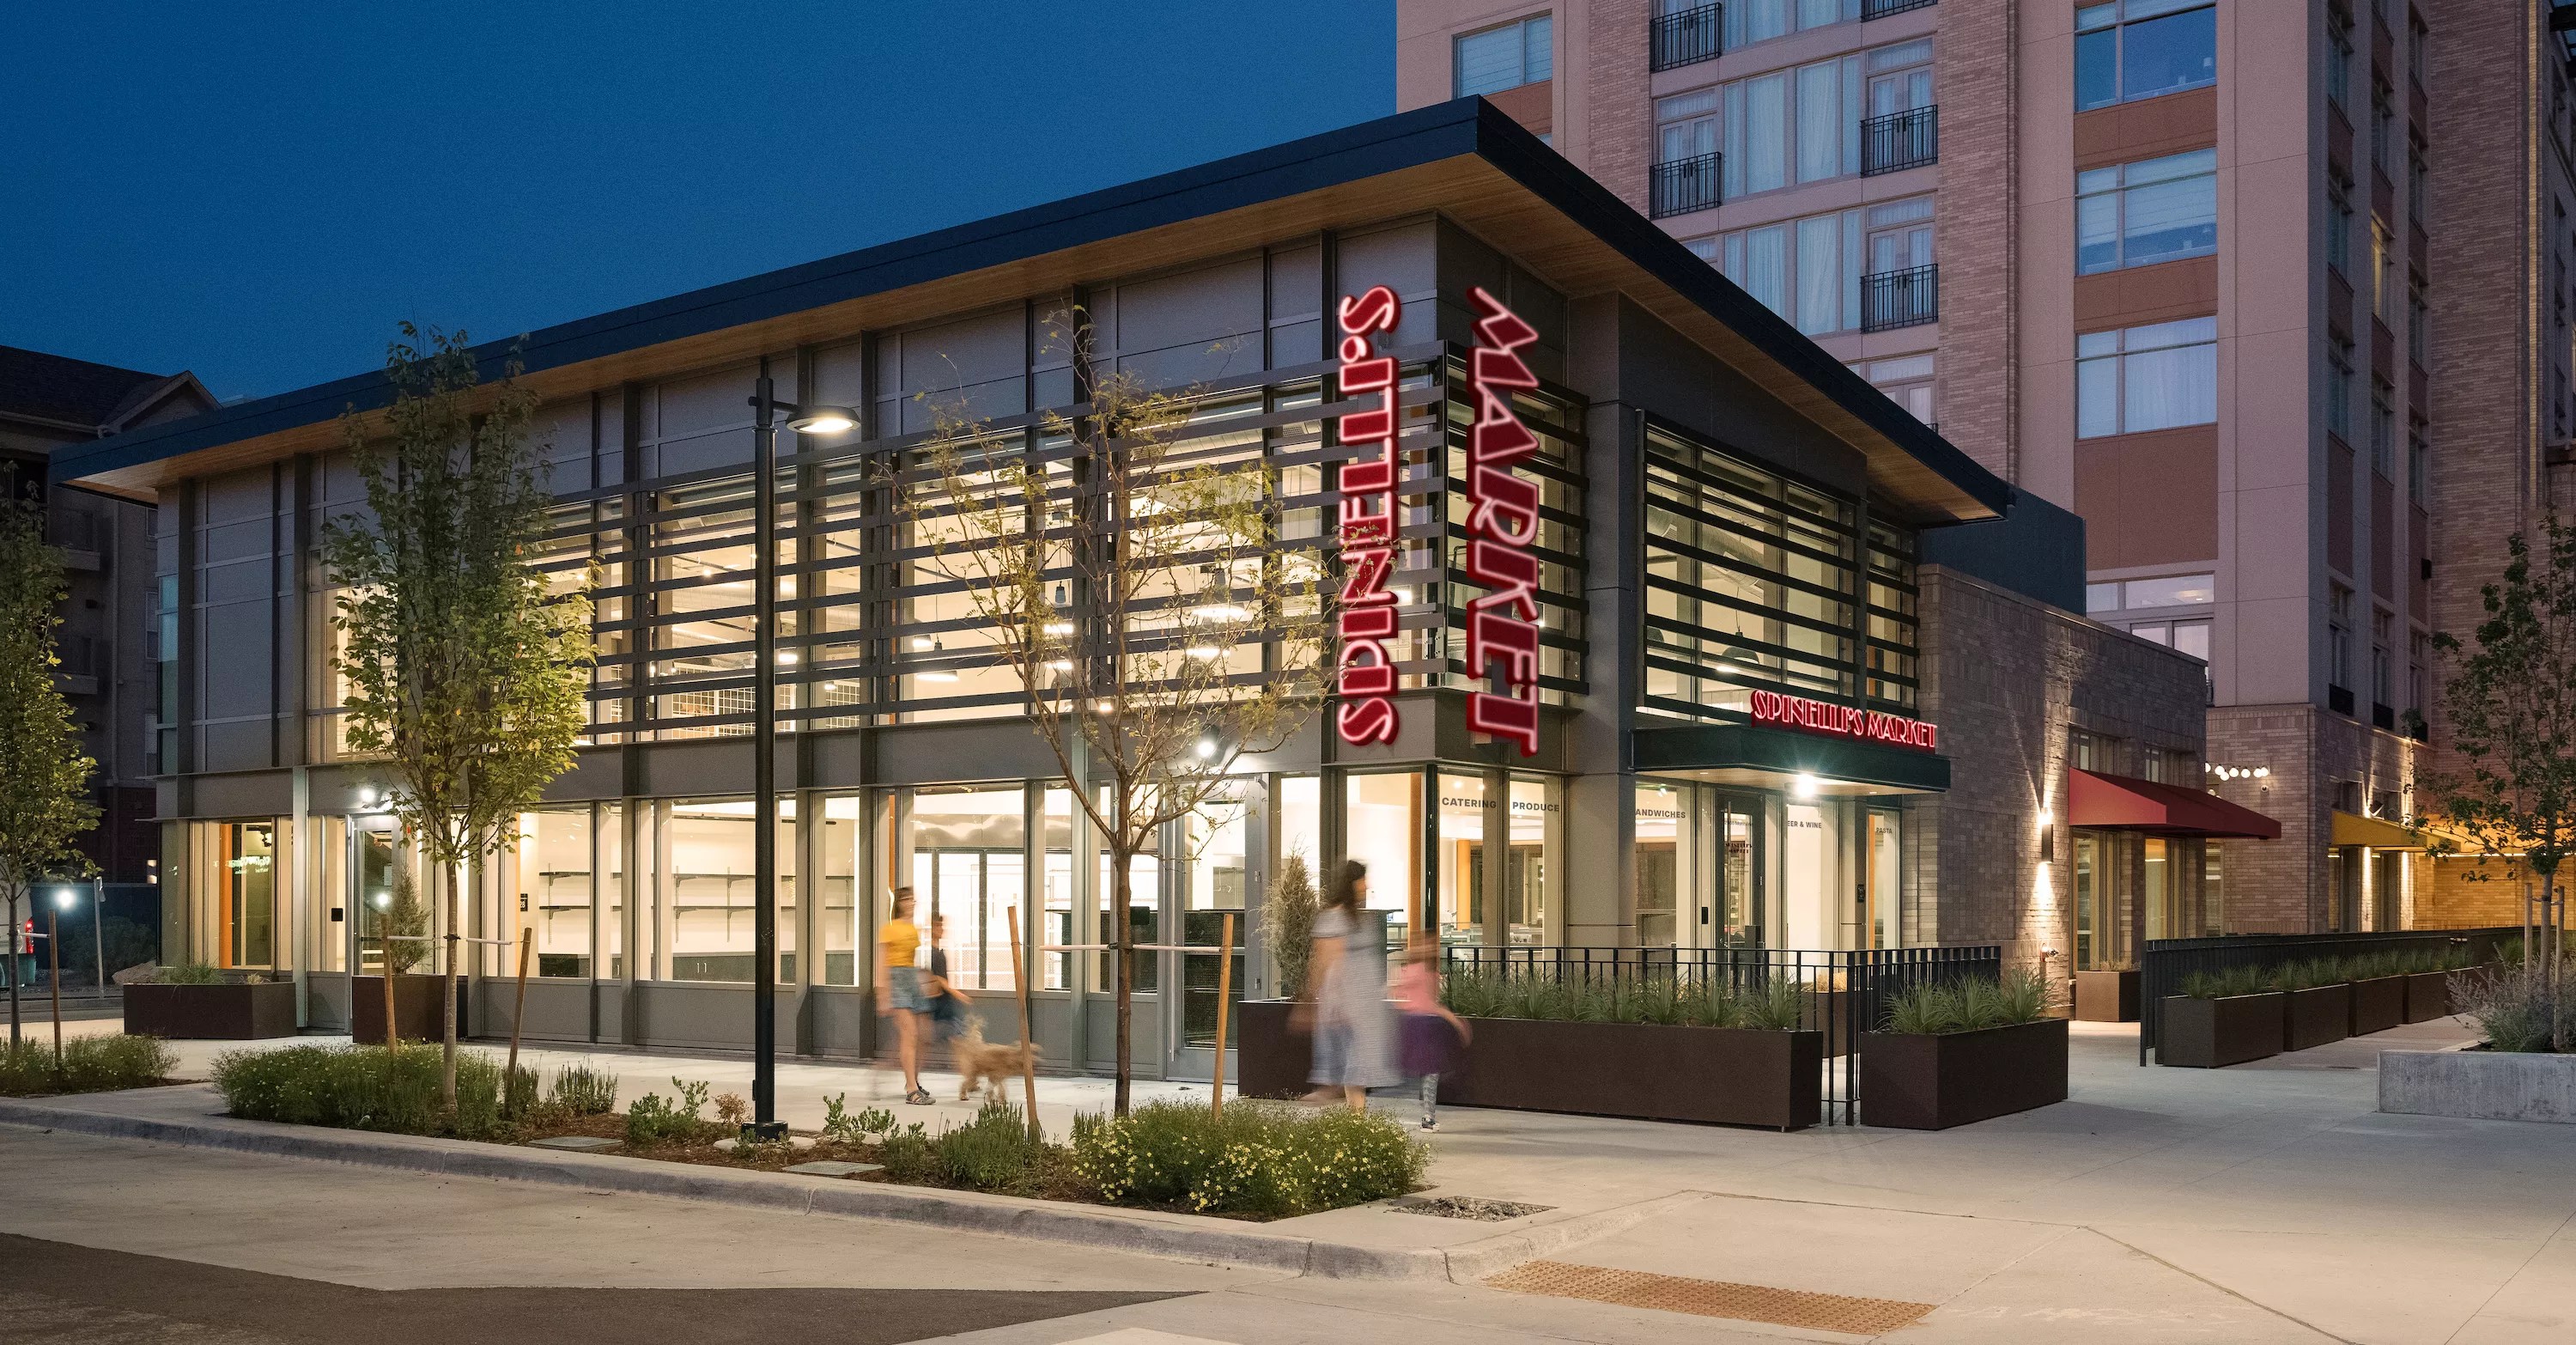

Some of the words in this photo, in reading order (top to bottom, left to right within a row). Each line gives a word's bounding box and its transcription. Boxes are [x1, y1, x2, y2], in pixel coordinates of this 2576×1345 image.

[1339, 285, 1400, 746] SPINELLI'S
[1467, 285, 1540, 758] MARKET
[1751, 690, 1863, 736] SPINELLI'S
[1866, 711, 1937, 749] MARKET
[1442, 797, 1497, 809] CATERING
[1512, 801, 1559, 812] PRODUCE
[1636, 808, 1686, 819] ANDWICHES
